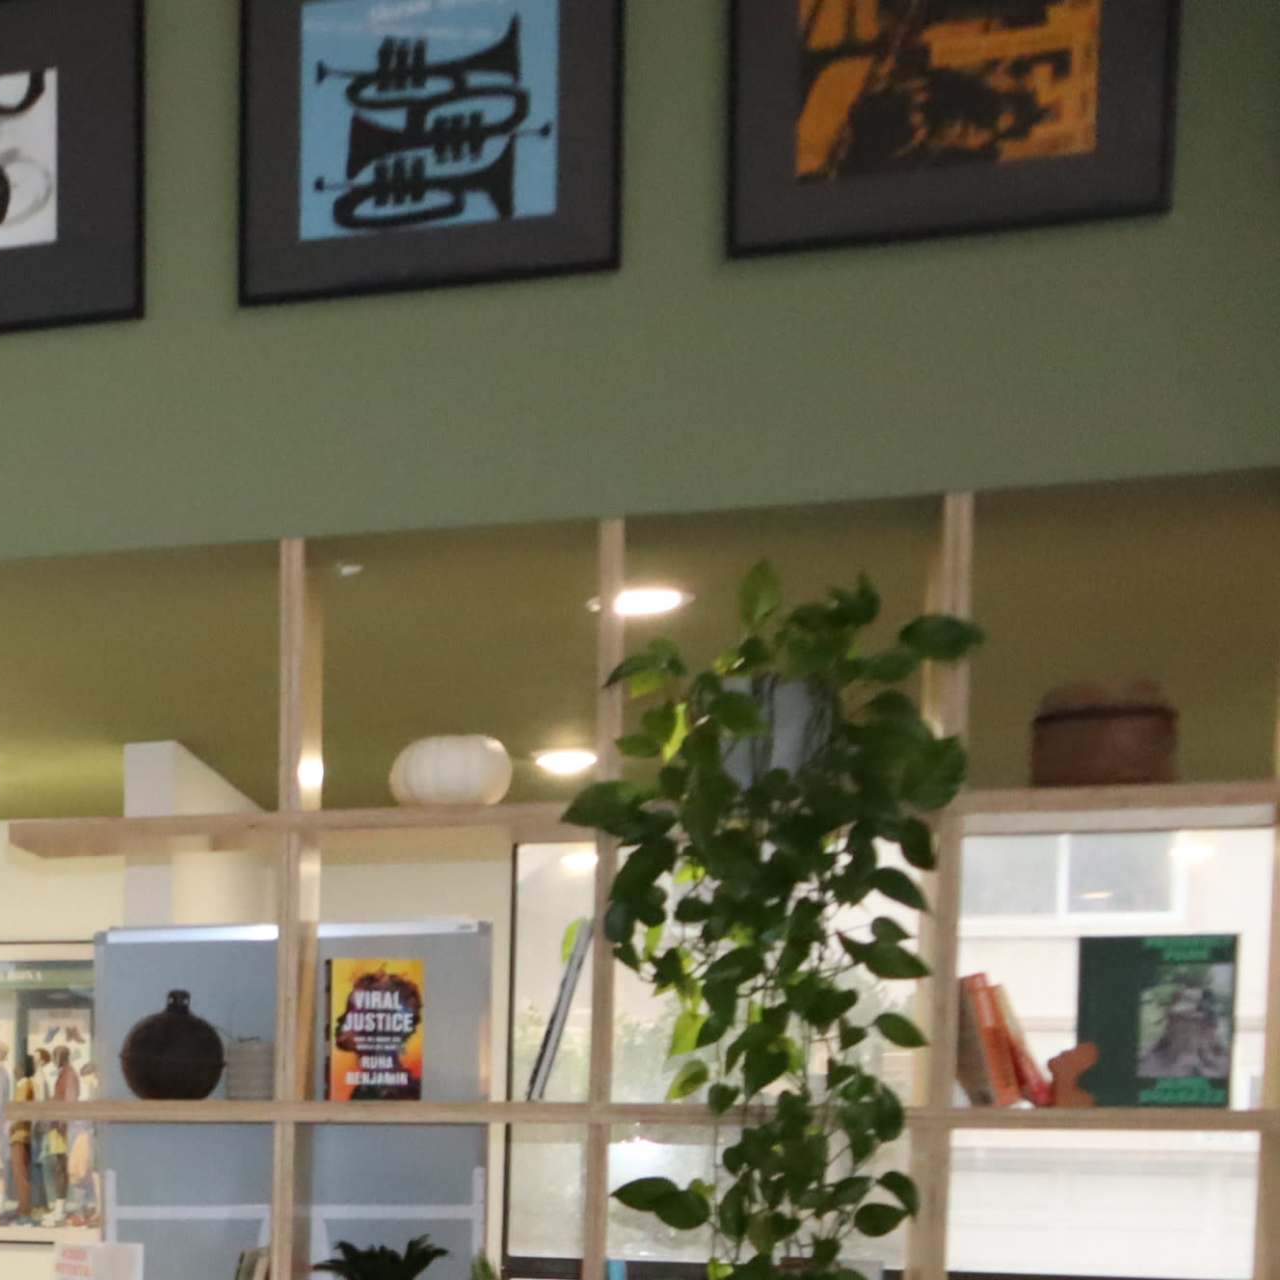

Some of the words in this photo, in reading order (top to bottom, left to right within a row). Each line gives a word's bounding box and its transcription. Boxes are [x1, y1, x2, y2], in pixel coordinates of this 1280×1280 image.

[354, 990, 403, 1010] VIRAL
[343, 1012, 414, 1033] JUSTICE
[345, 1072, 409, 1085] BENJAMIN
